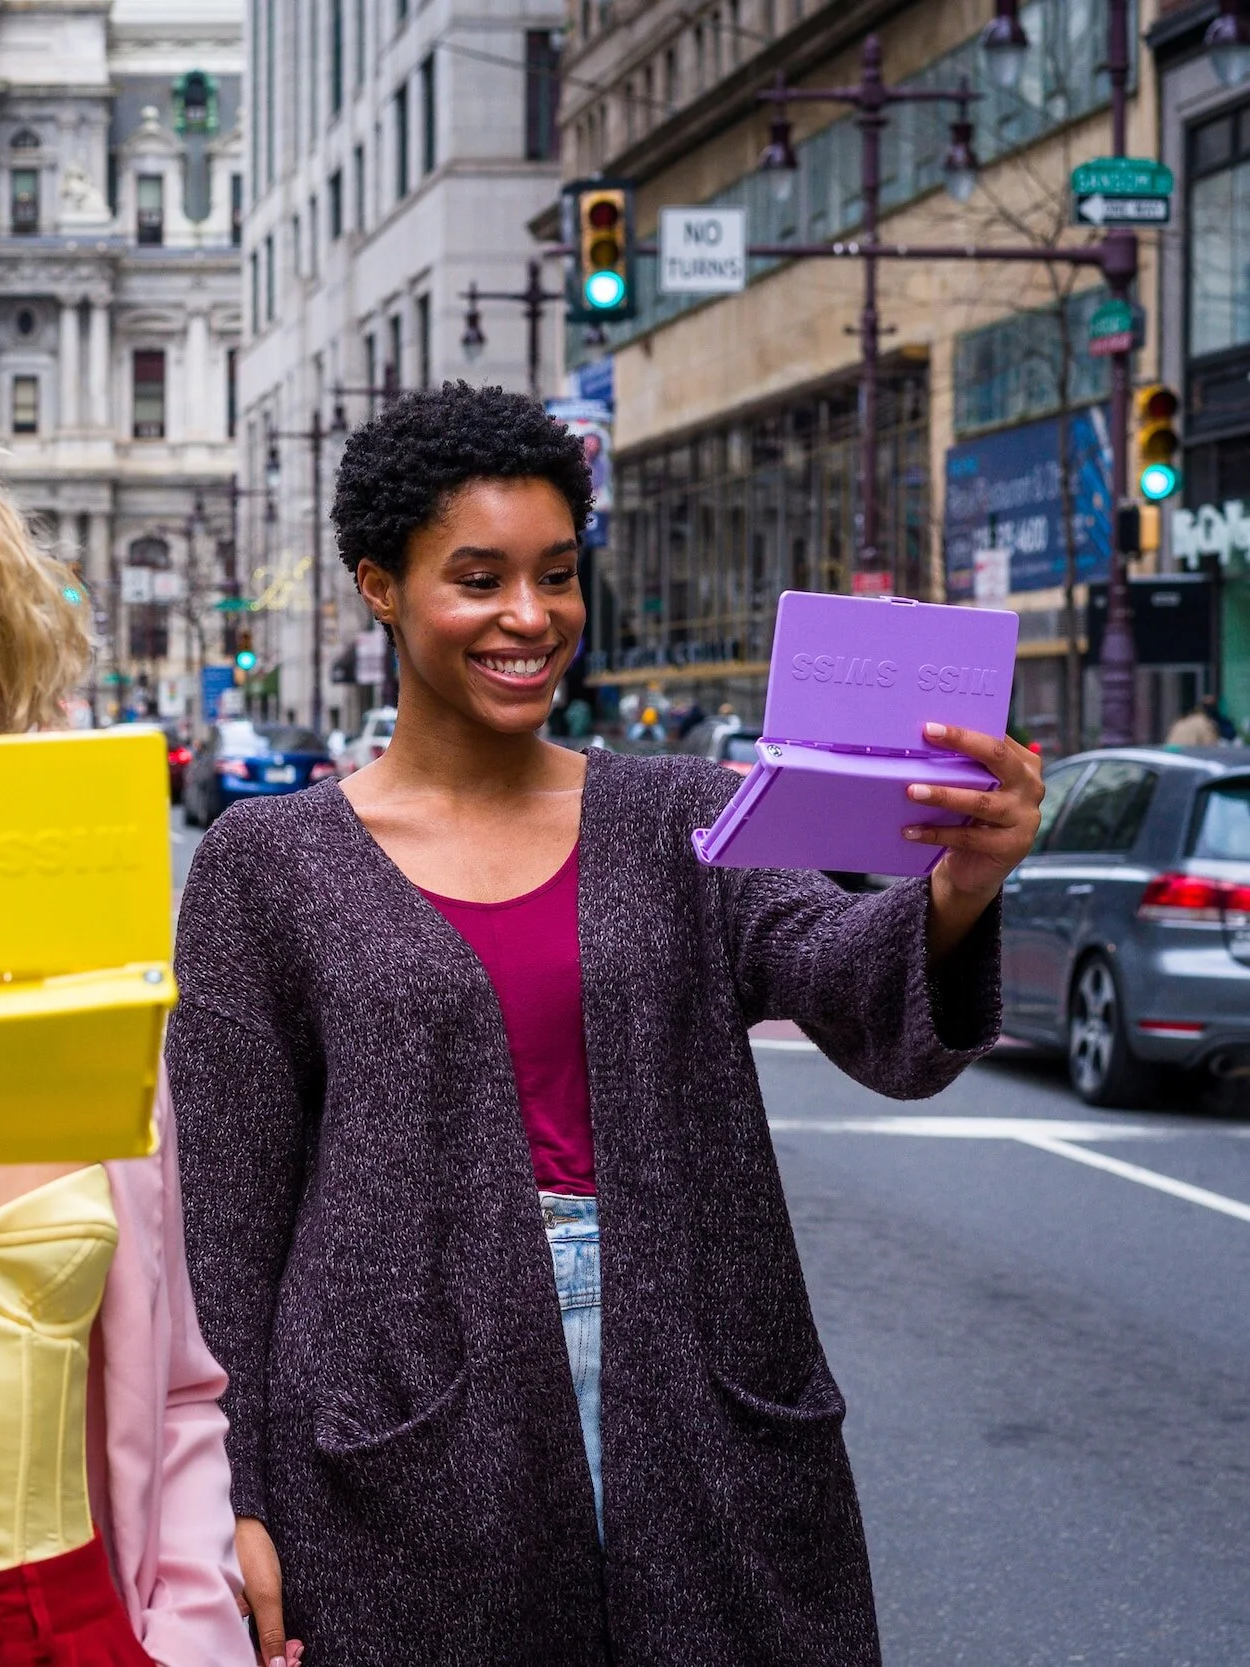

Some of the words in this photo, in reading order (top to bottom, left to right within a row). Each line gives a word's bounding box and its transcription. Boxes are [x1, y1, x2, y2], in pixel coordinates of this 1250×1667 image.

[683, 219, 723, 247] NO
[668, 258, 745, 279] TURNS
[791, 652, 899, 688] SWISS
[917, 663, 998, 698] MISS
